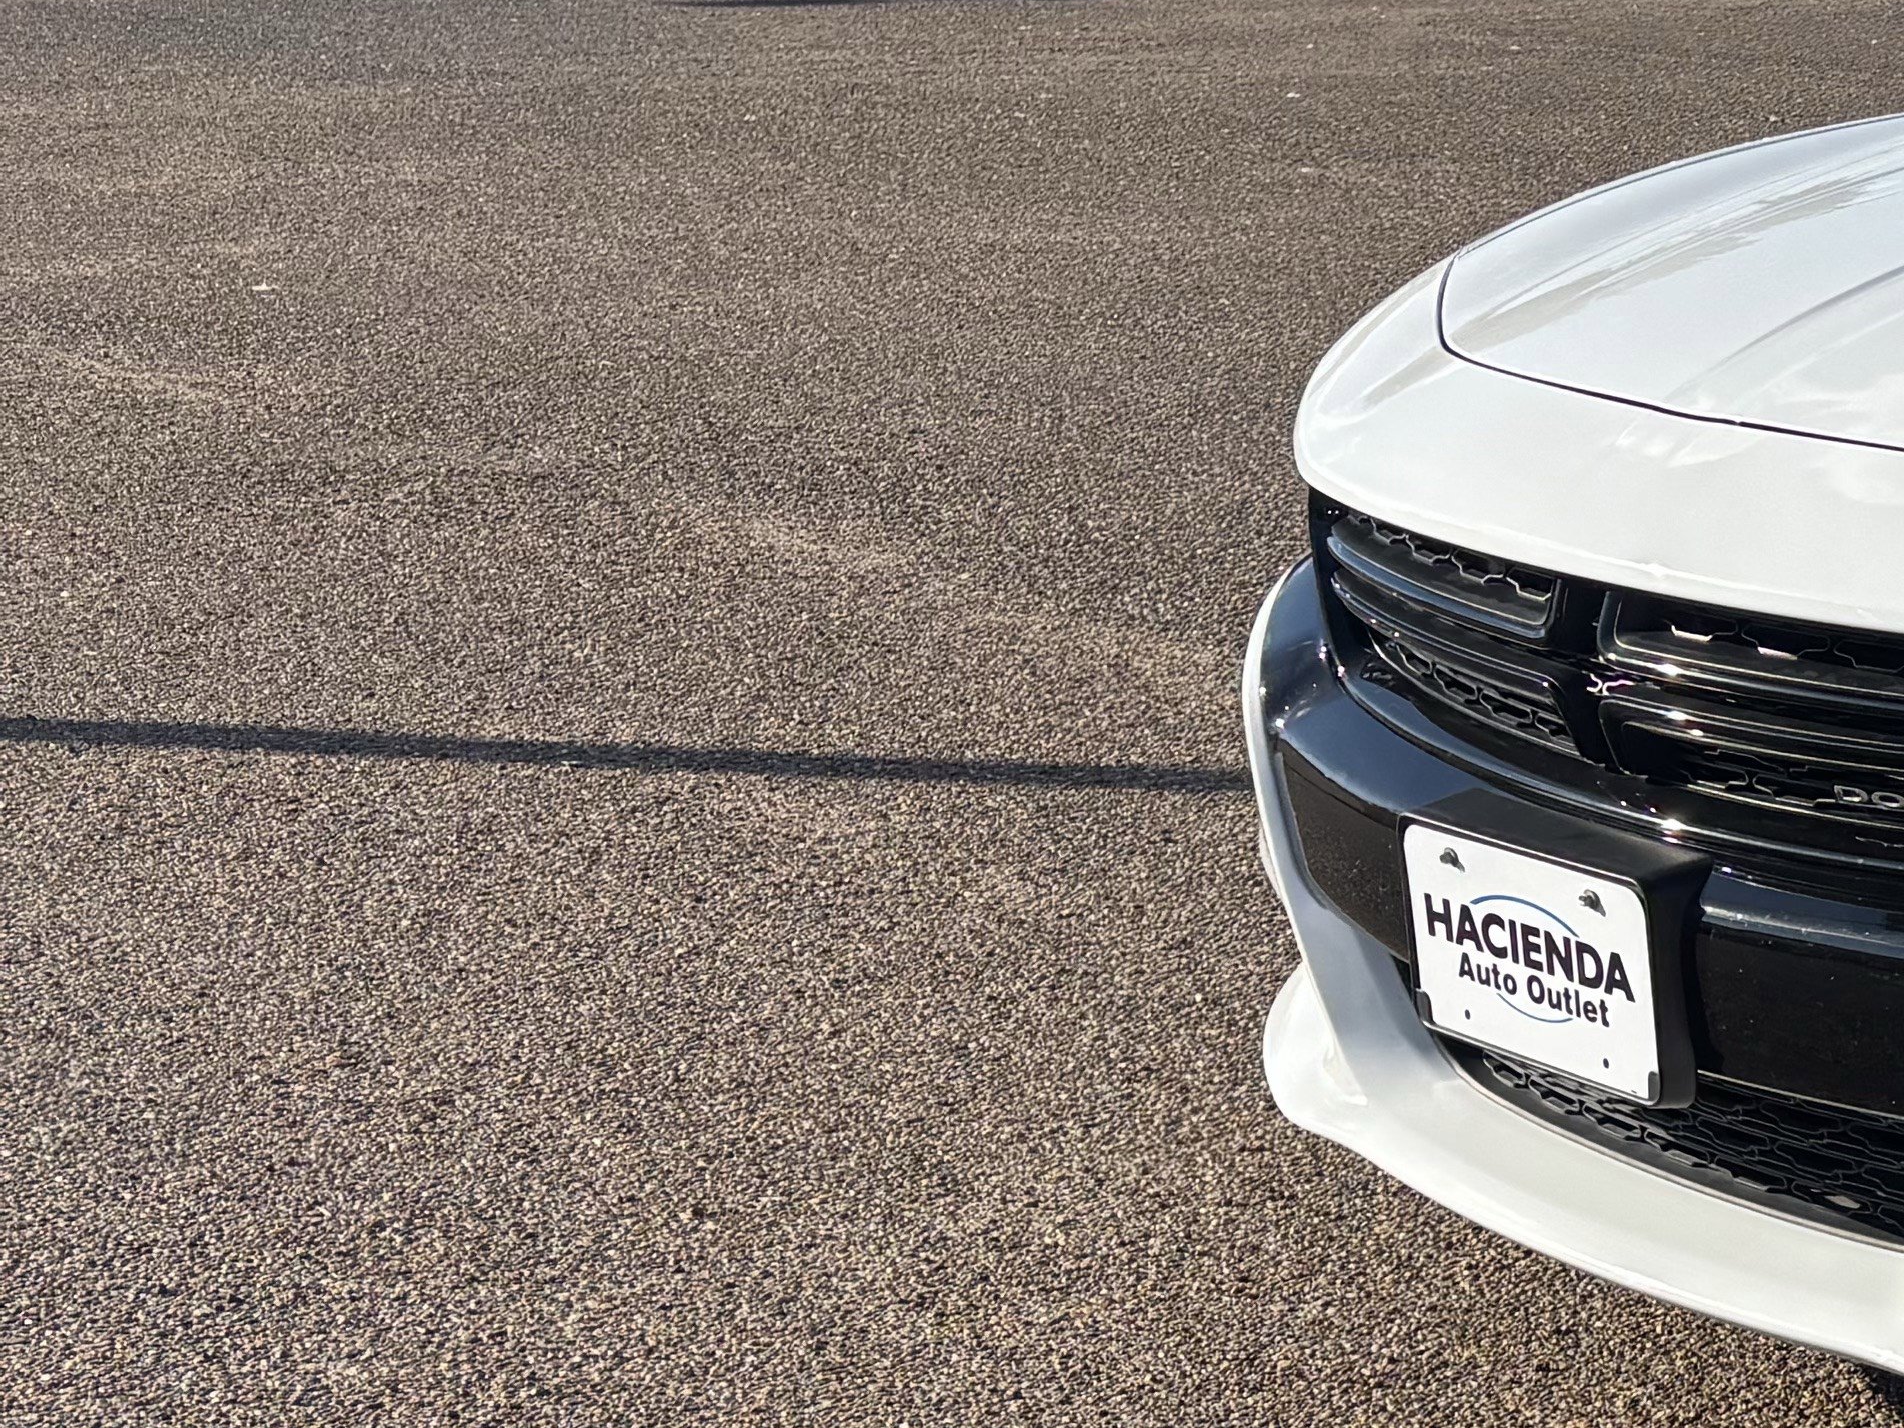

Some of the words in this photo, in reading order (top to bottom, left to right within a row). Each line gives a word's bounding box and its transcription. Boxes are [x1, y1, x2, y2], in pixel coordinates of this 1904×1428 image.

[1424, 893, 1636, 1003] HACIENDA
[1459, 952, 1517, 996] Auto
[1527, 975, 1610, 1028] Outlet
